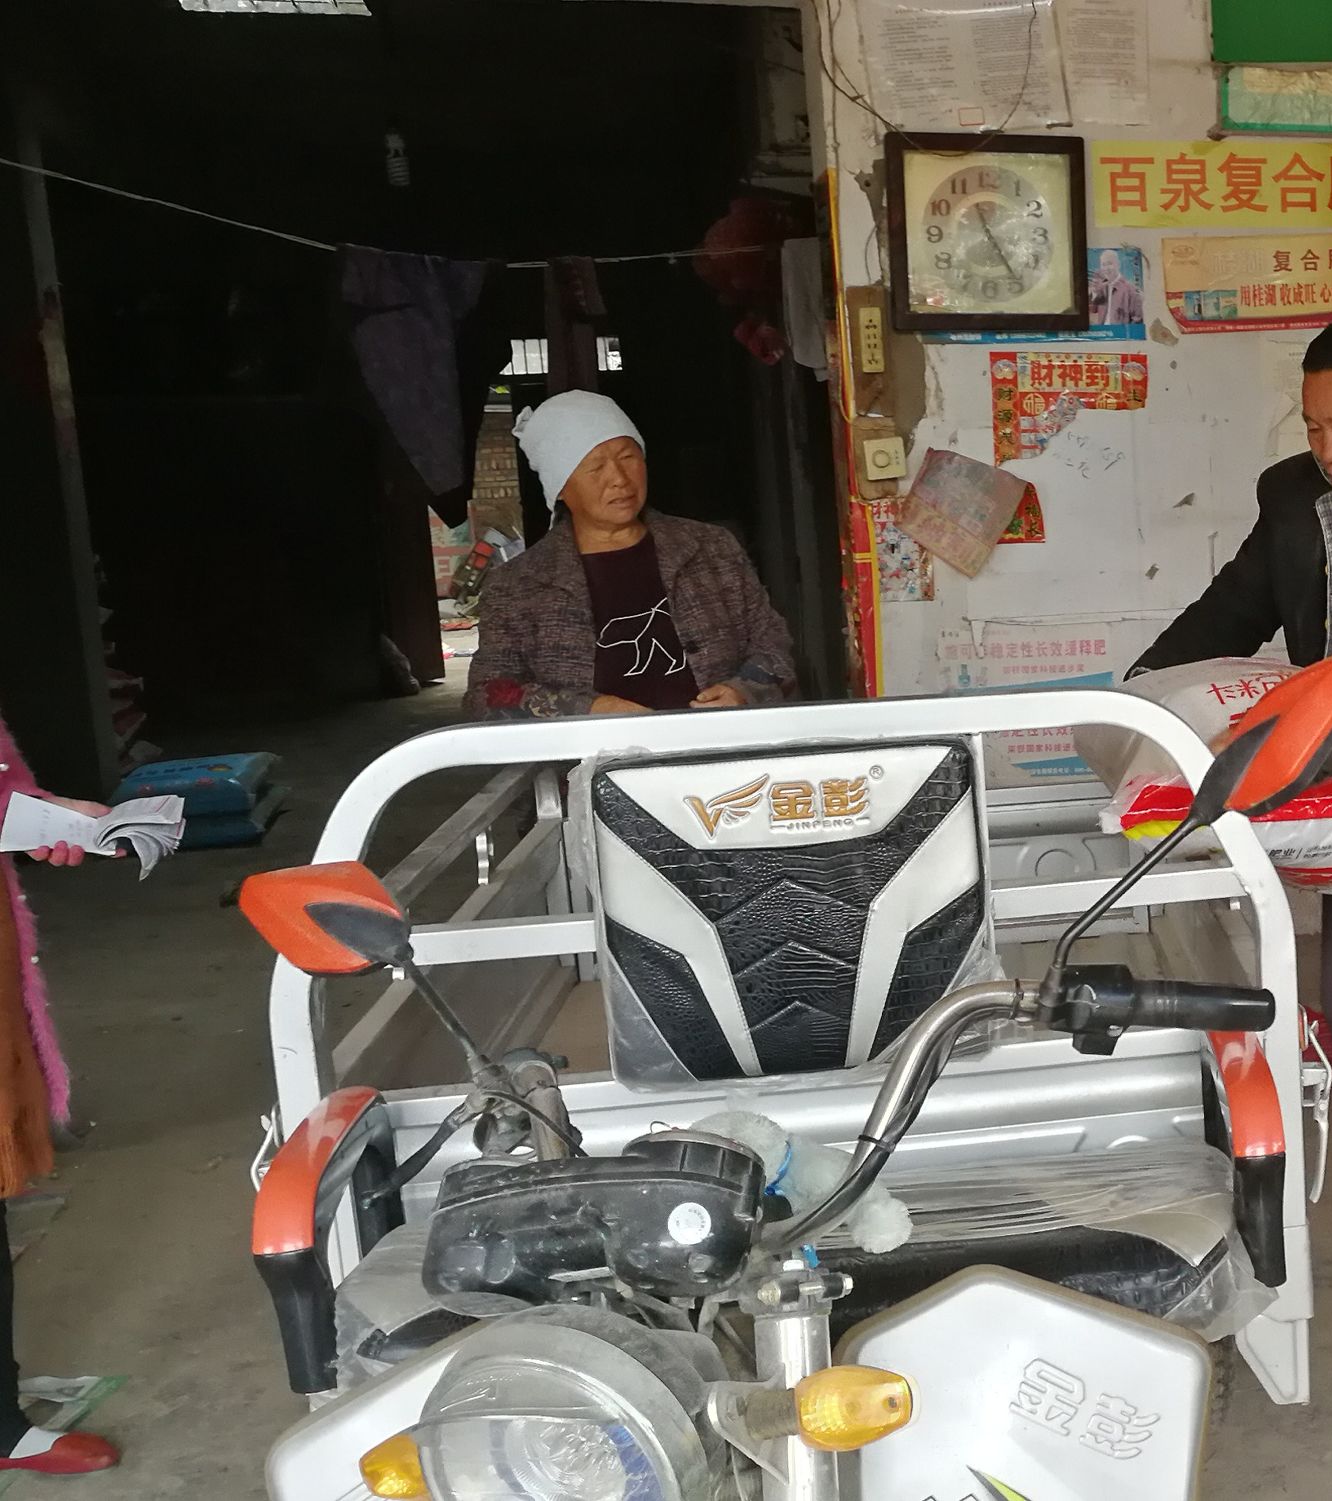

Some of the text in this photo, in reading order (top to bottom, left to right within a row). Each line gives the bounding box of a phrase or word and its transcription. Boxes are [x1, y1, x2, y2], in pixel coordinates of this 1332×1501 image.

[950, 177, 967, 195] 11
[930, 198, 950, 217] 10
[1026, 199, 1043, 219] 2
[926, 224, 943, 244] 9
[1032, 226, 1049, 246] 3
[934, 251, 951, 271] 8
[981, 279, 998, 299] 6
[1030, 360, 1110, 388] 財神到
[770, 776, 869, 822] 金彭
[786, 819, 854, 830] JINPENG
[1009, 1357, 1161, 1461] 金彭
